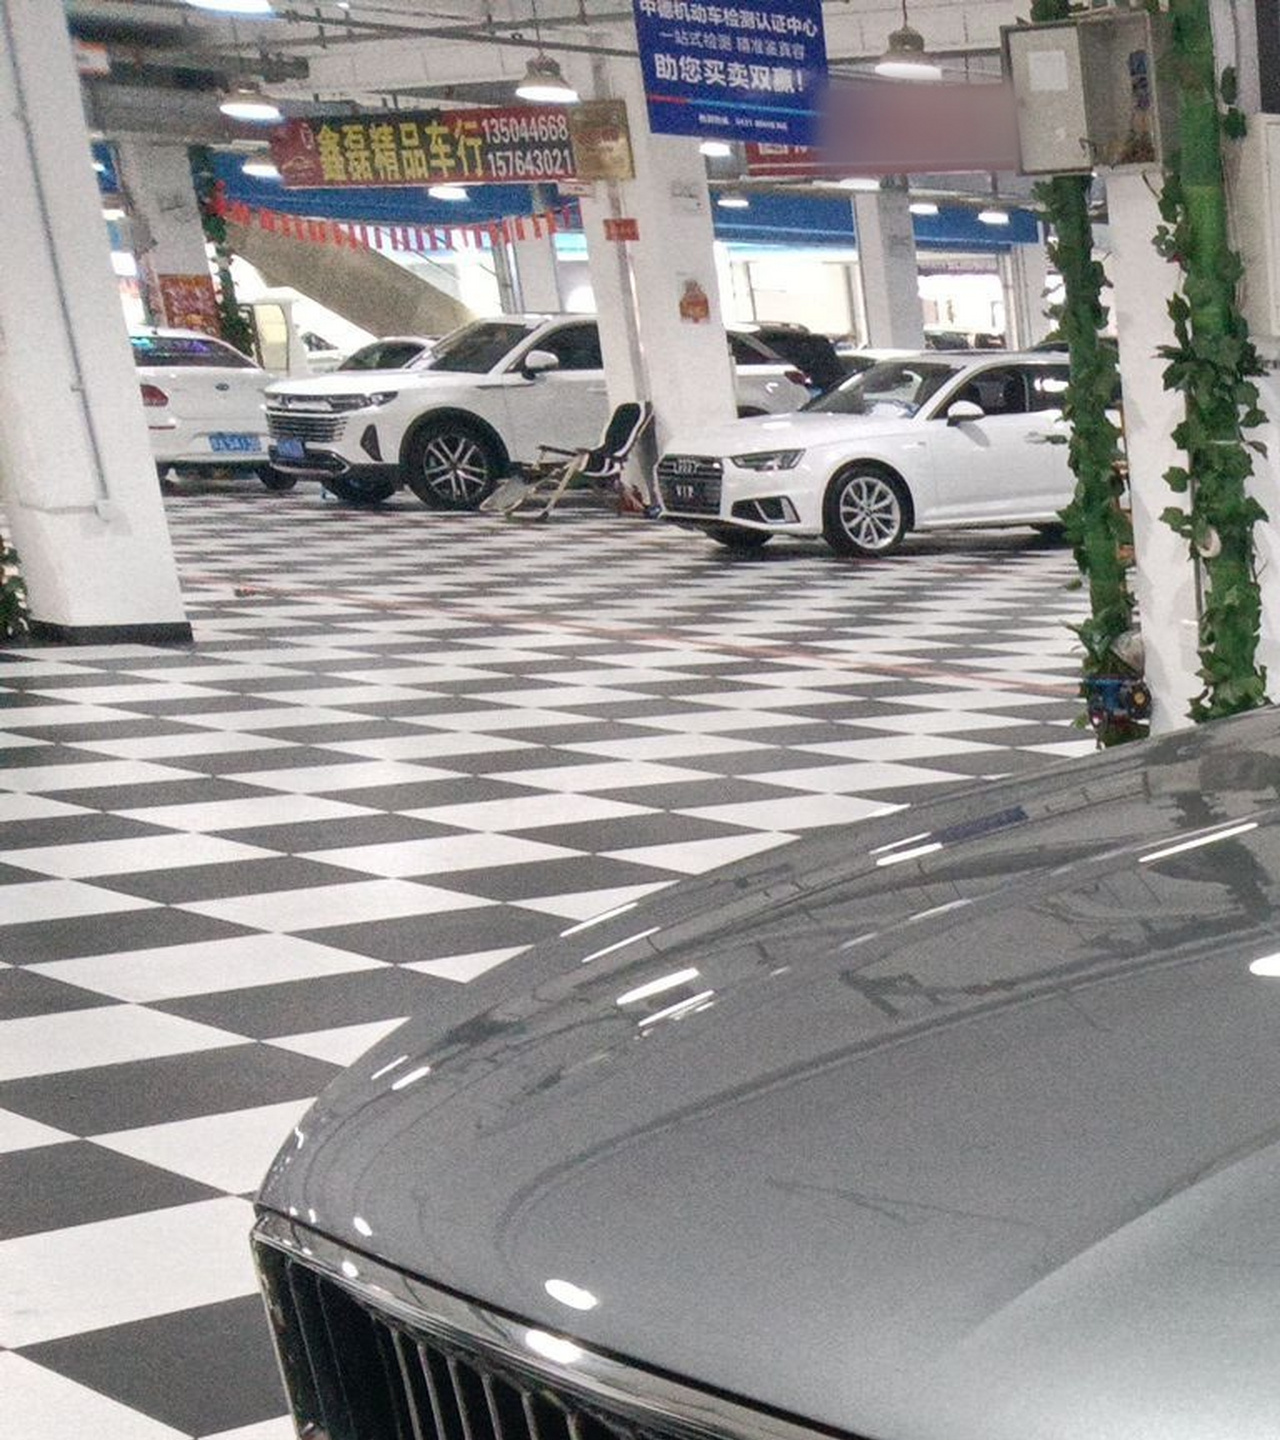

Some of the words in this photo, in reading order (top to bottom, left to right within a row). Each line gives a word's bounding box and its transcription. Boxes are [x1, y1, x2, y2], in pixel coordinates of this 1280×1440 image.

[481, 115, 569, 144] 135044668
[317, 119, 482, 181] 鑫磊精品车行
[487, 149, 573, 178] 157643021
